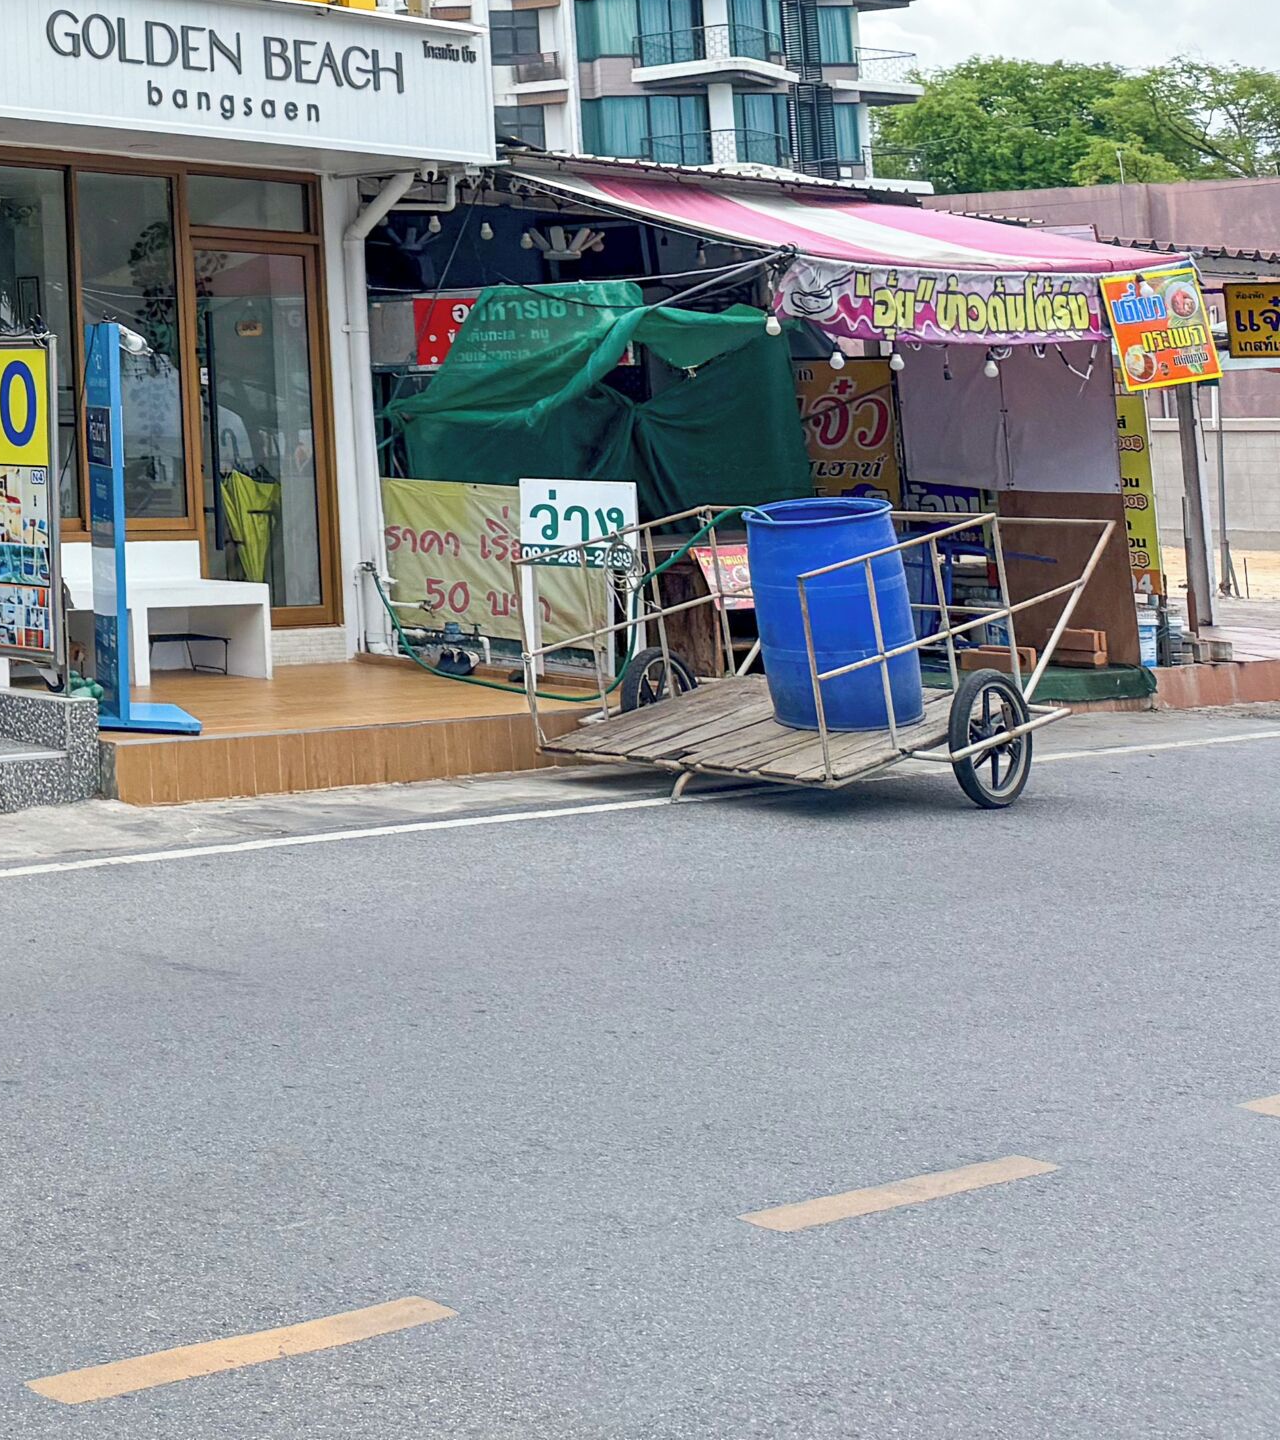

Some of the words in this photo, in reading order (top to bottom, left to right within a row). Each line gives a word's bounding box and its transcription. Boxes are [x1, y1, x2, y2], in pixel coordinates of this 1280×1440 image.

[46, 9, 243, 75] GOLDEN
[264, 36, 405, 95] BEACH
[147, 80, 321, 122] bangsaen
[1238, 335, 1280, 352] เกสท์เ
[797, 378, 889, 448] จ๋ว
[810, 454, 888, 478] เฮาท์
[529, 489, 625, 543] ว่าง
[384, 526, 461, 558] ราคา
[426, 577, 470, 614] 50
